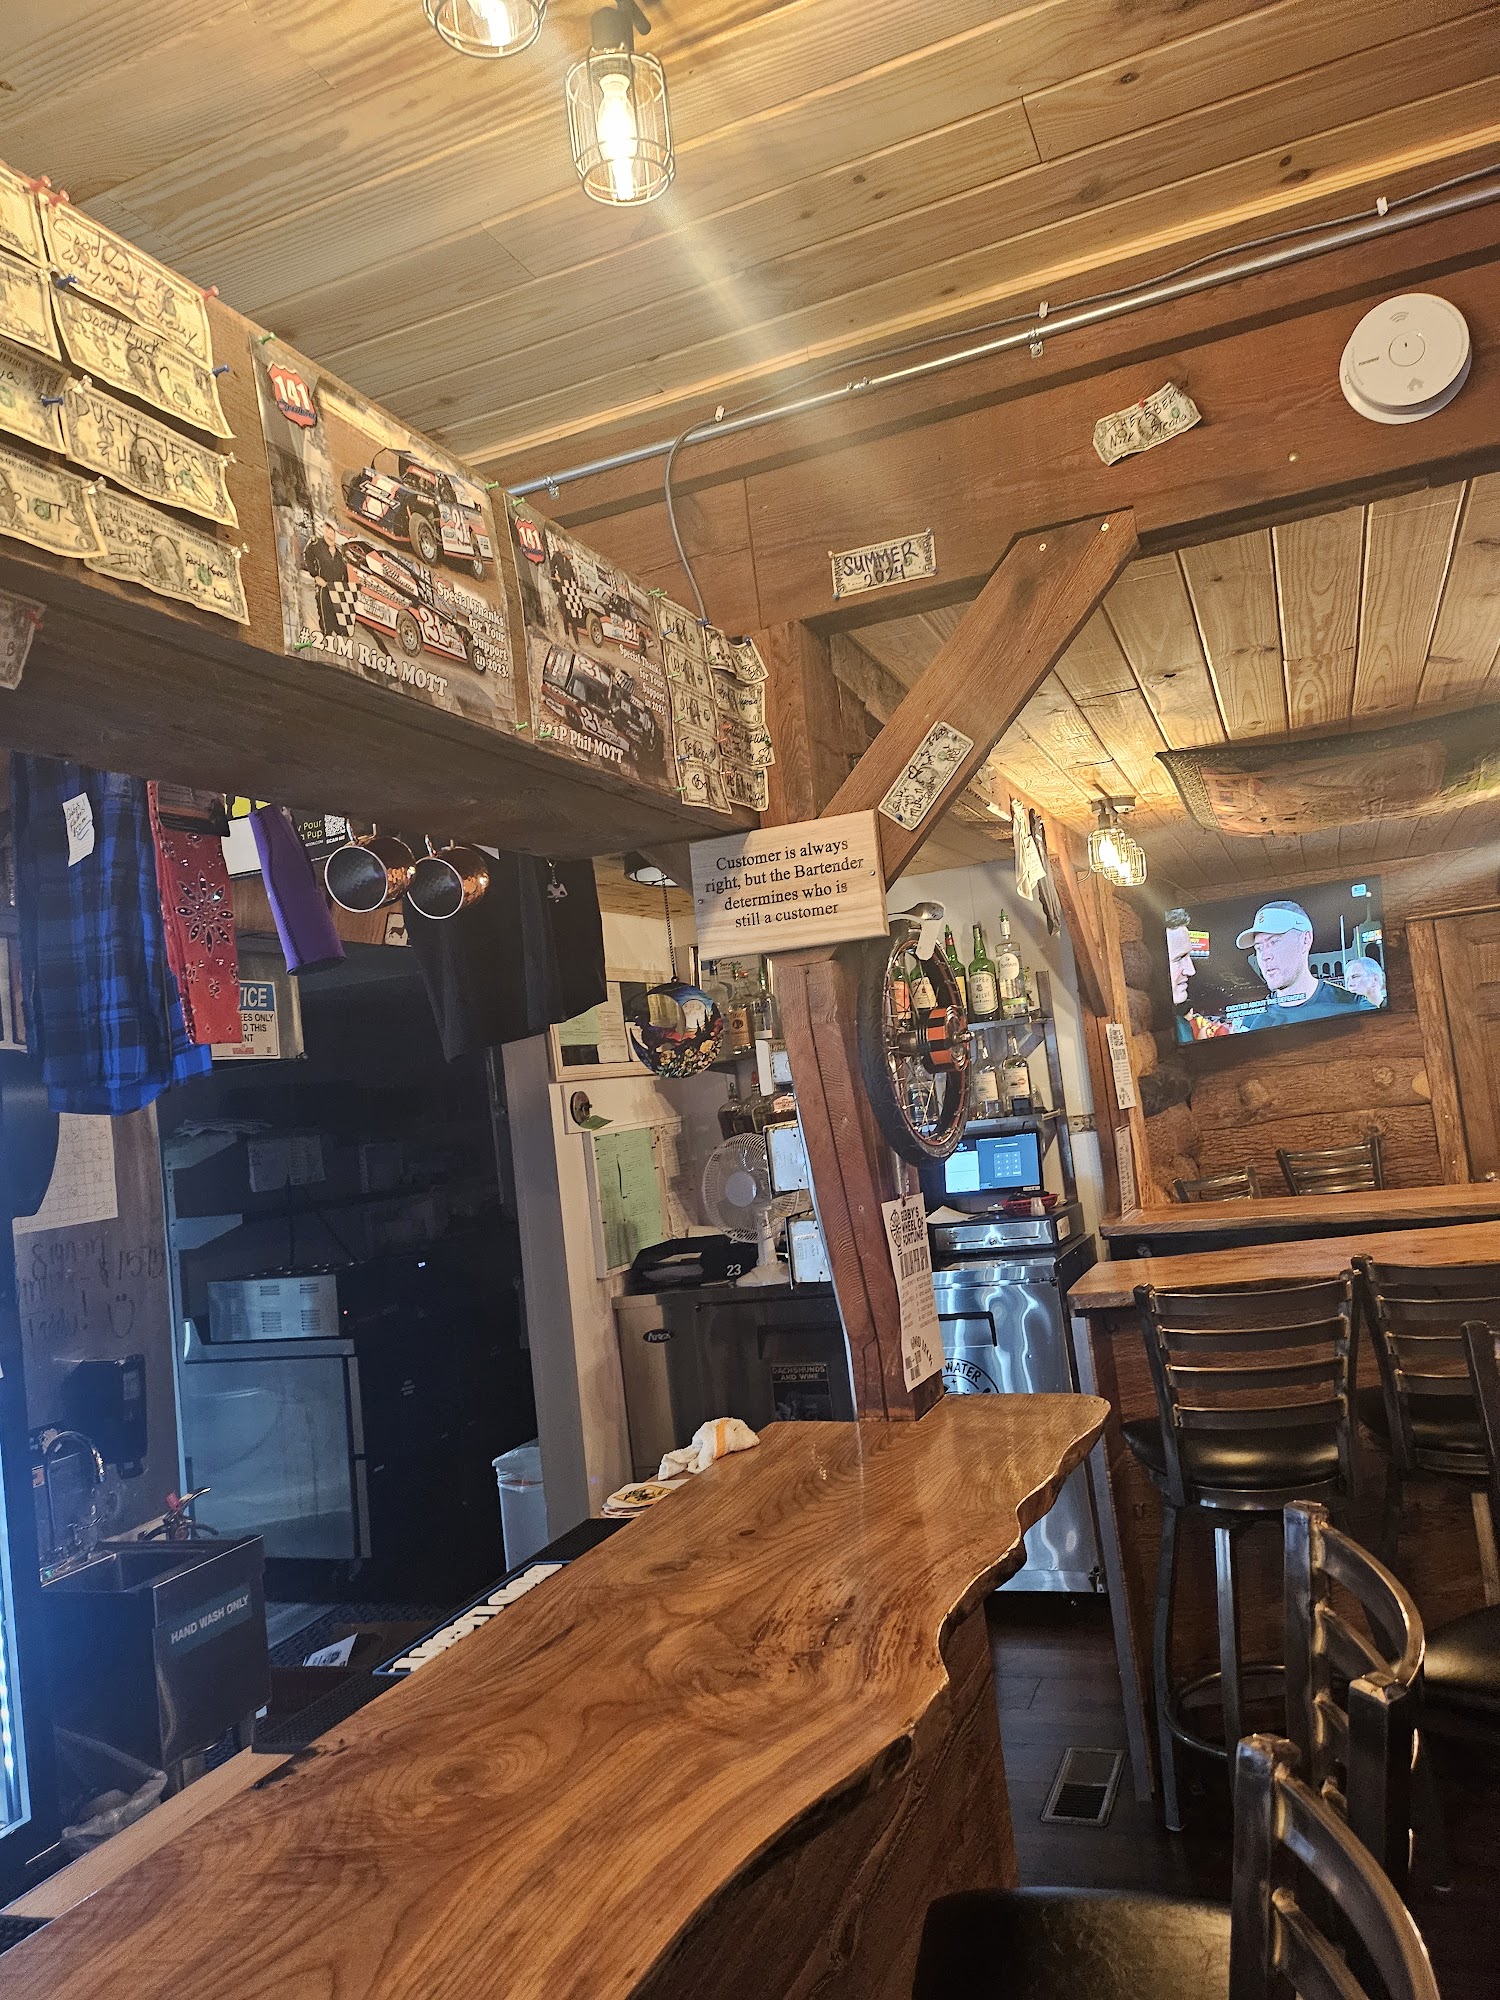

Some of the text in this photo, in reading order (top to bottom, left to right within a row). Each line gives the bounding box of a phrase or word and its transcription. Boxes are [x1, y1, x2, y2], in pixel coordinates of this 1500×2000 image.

[275, 375, 310, 411] 141
[519, 527, 541, 550] 141
[843, 541, 918, 577] SUMMER
[864, 564, 906, 587] 2024
[437, 581, 471, 609] Special
[468, 598, 504, 627] Thanks
[469, 614, 505, 641] for Your
[625, 620, 639, 642] 21
[473, 633, 508, 661] Support
[619, 644, 640, 663] Special
[299, 627, 448, 697] #21M Rick MOTT
[475, 651, 486, 667] in
[570, 729, 592, 752] Phil
[594, 739, 624, 764] MOTT
[303, 820, 322, 831] Pour
[307, 829, 323, 840] Pup
[716, 839, 849, 870] Customer is always
[705, 857, 864, 894] right, but the Bartender
[724, 880, 848, 911] determines who is
[735, 904, 839, 928] still a customer
[251, 1024, 267, 1032] THIS
[255, 1014, 273, 1022] ONLY
[917, 1217, 924, 1230] OF
[902, 1229, 924, 1246] FORTUNE
[726, 1264, 742, 1276] 23
[772, 1365, 825, 1374] DACHSHUNDS
[945, 1361, 982, 1383] WATER
[171, 1594, 249, 1645] HAND WASH ONLY
